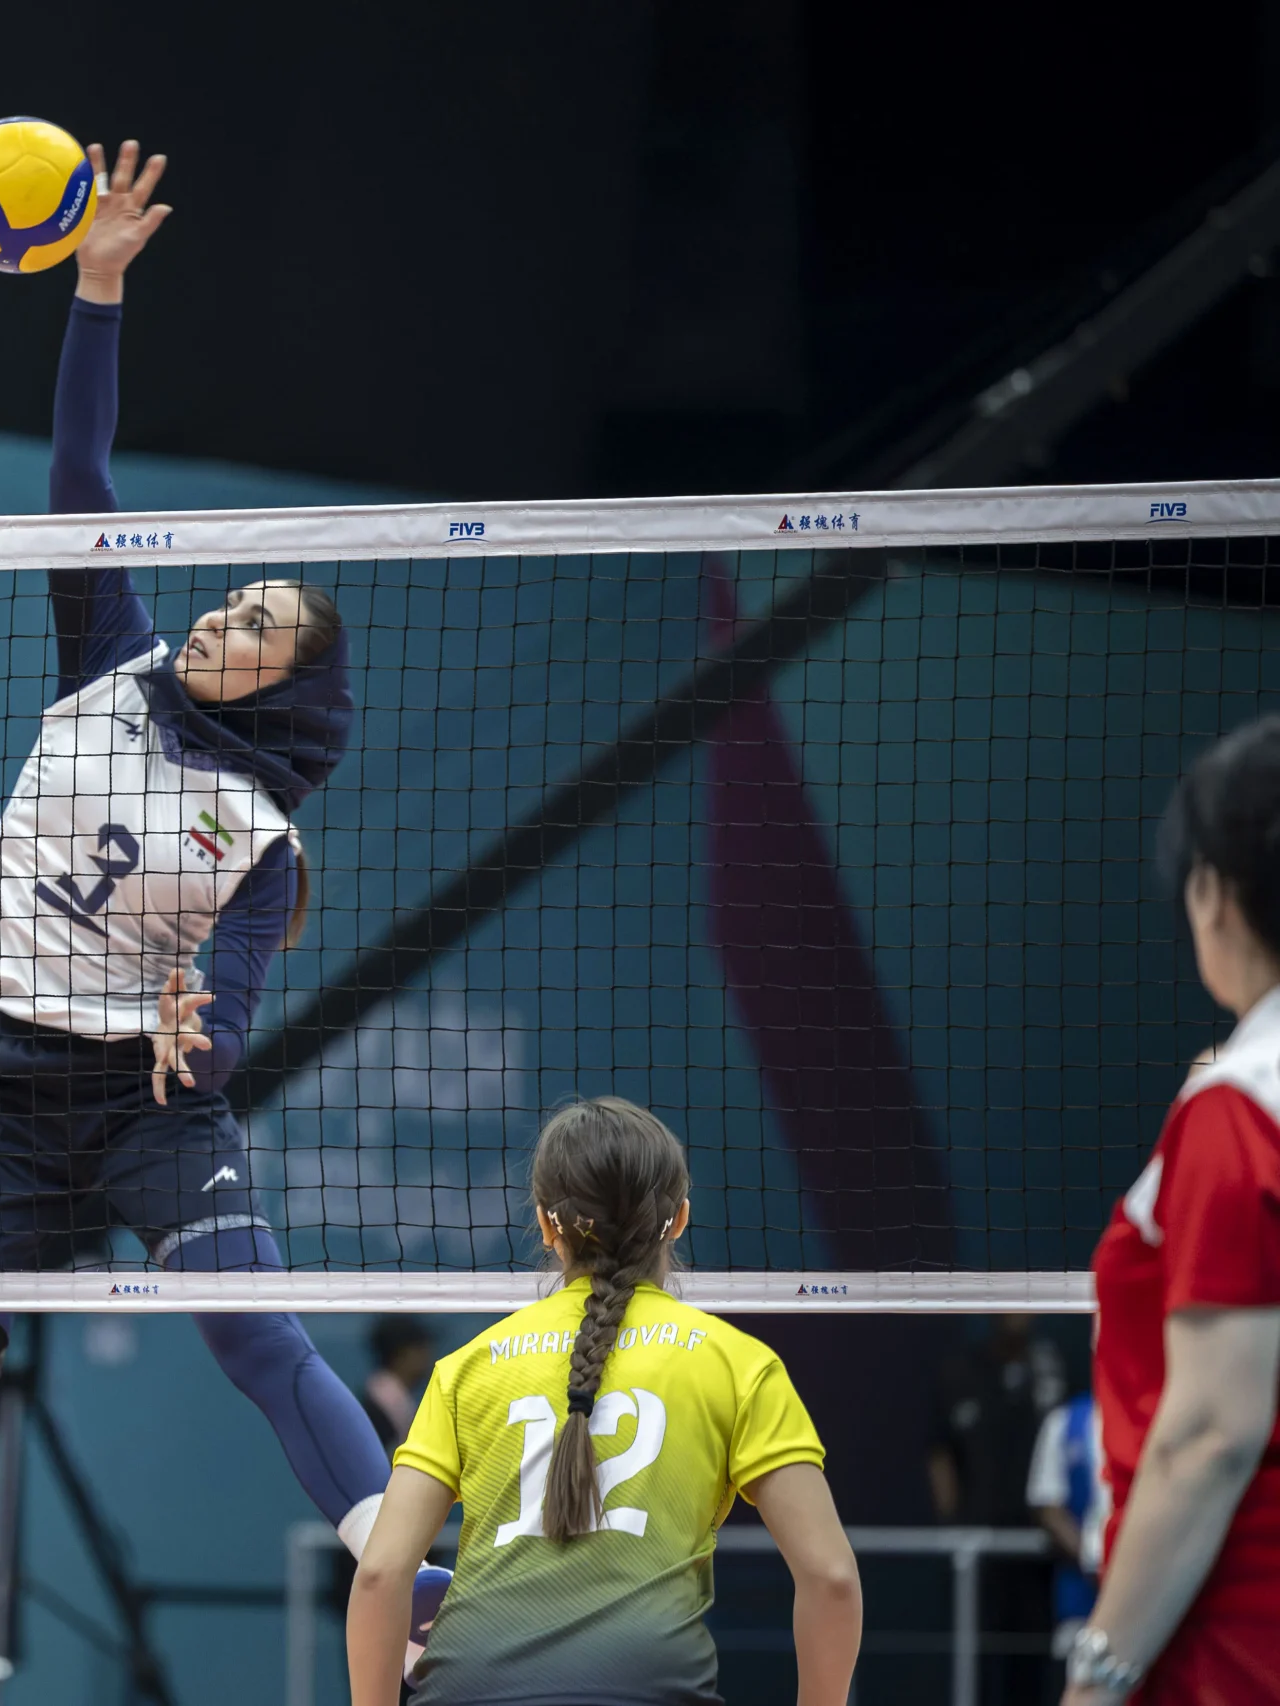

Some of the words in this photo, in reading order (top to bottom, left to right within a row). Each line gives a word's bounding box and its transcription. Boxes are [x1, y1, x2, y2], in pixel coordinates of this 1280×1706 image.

[1150, 502, 1187, 517] FIVB
[449, 522, 485, 536] FIVB
[493, 1387, 667, 1548] 12
